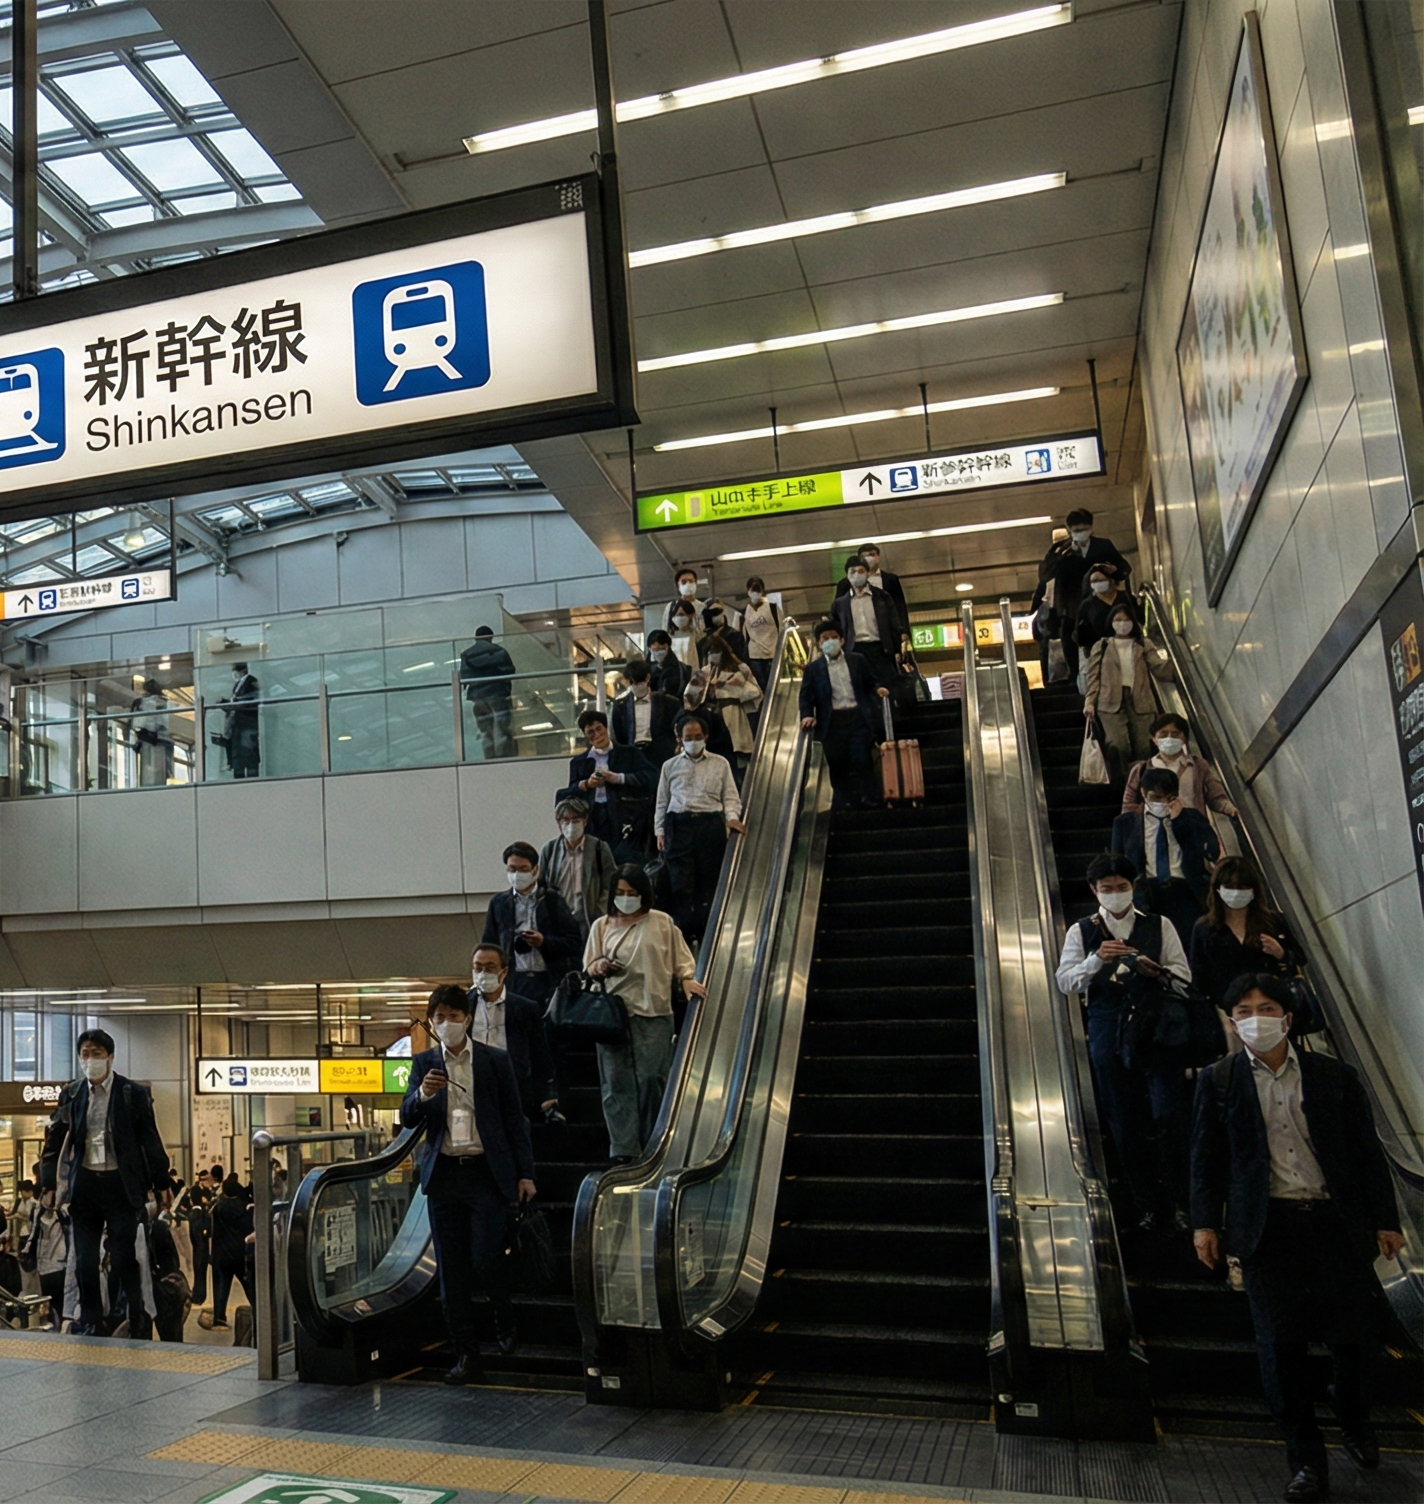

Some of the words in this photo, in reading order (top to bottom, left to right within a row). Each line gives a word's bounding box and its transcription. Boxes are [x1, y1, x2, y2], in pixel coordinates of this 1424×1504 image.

[83, 299, 309, 406] 新幹線
[85, 388, 313, 452] Shinkansen
